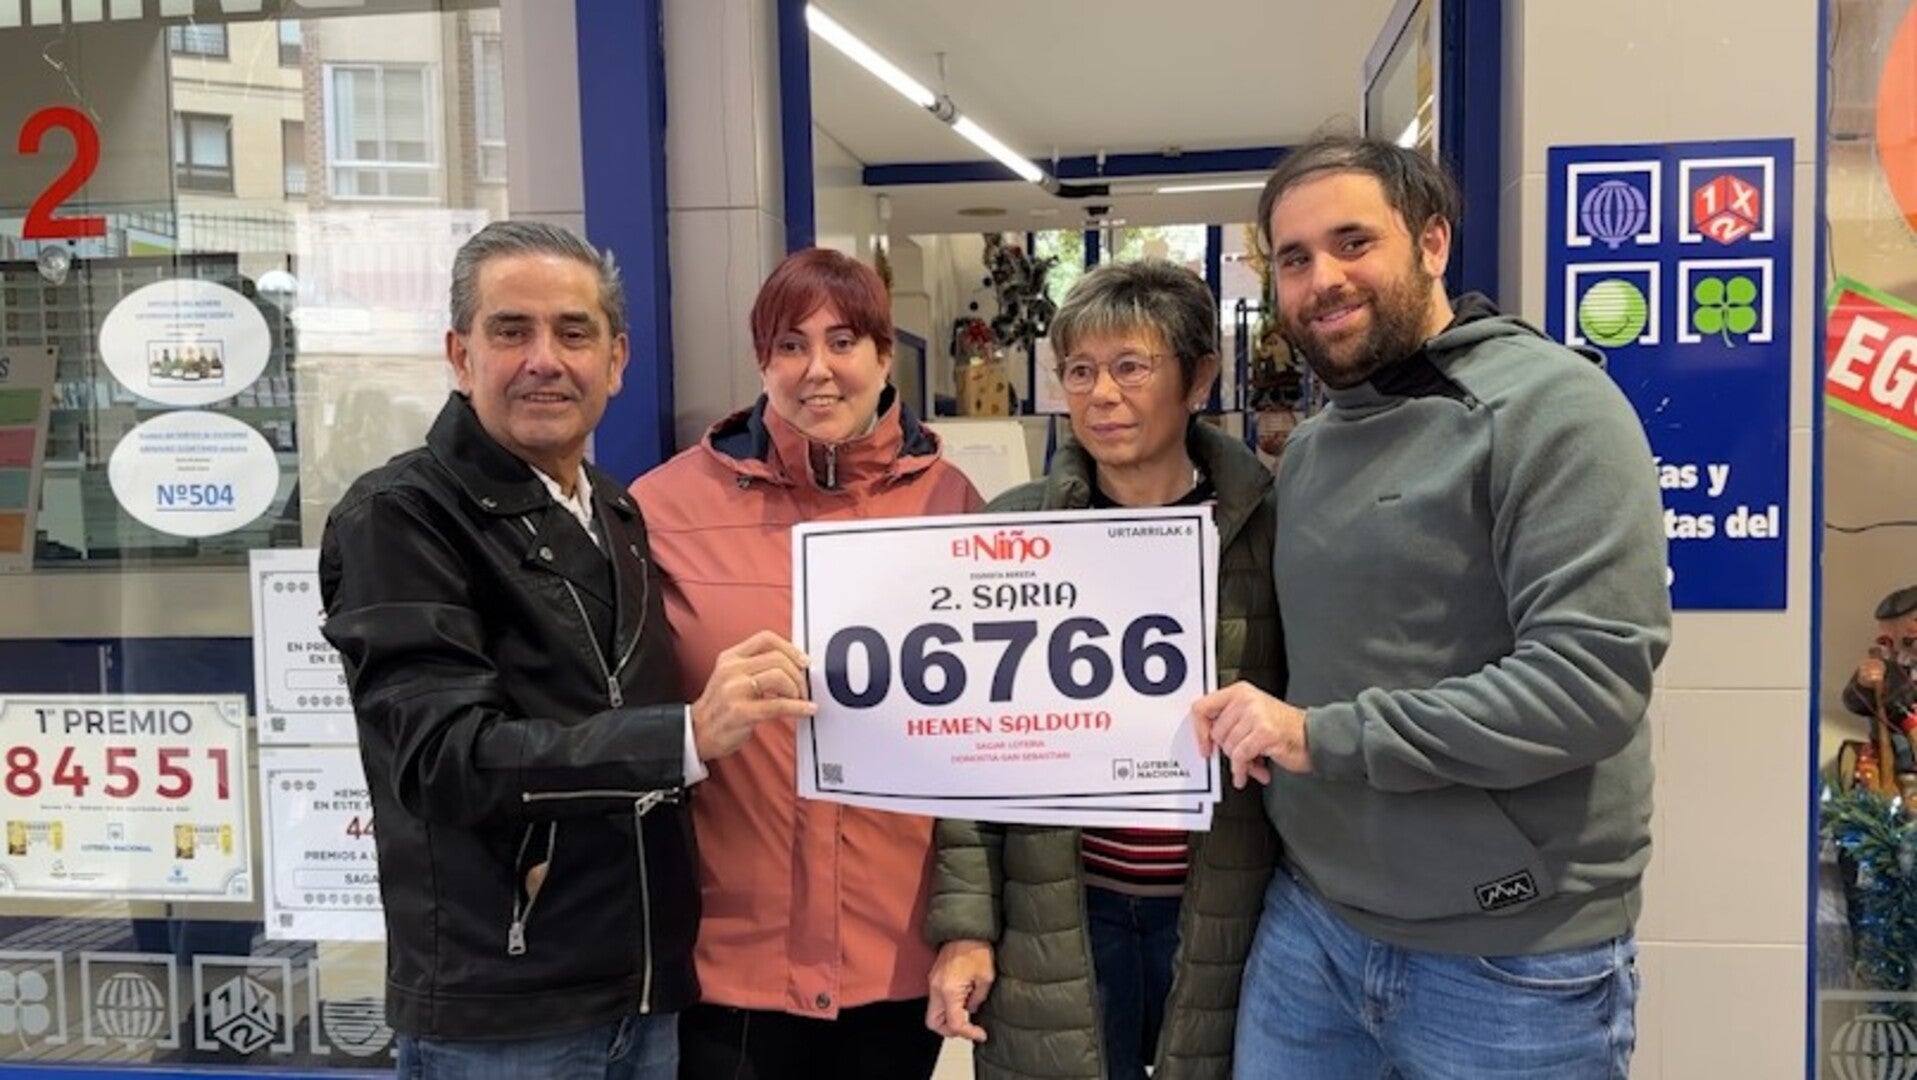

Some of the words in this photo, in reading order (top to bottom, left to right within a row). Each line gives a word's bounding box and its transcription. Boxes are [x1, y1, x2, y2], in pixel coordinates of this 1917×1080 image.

[18, 105, 107, 241] 2
[1826, 313, 1917, 416] EG
[1707, 463, 1730, 498] y
[156, 484, 235, 506] Nº504
[1107, 526, 1184, 539] URTARRILAK
[1186, 526, 1194, 537] 6
[1725, 504, 1780, 539] del
[951, 539, 971, 558] El
[973, 530, 1052, 563] Niño
[930, 586, 962, 610] 2.
[972, 581, 1077, 610] SARIA
[287, 642, 303, 652] EN
[309, 654, 325, 664] EN
[825, 613, 1188, 709] 06766
[63, 709, 193, 735] PREMIO
[906, 717, 993, 737] HEMEN
[999, 711, 1112, 734] SALDUTA
[4, 746, 230, 800] 84551
[1136, 769, 1191, 778] NACIONAL
[313, 801, 330, 811] EN
[332, 801, 362, 811] ESTE
[304, 851, 357, 861] PREMIOS
[360, 851, 368, 860] A
